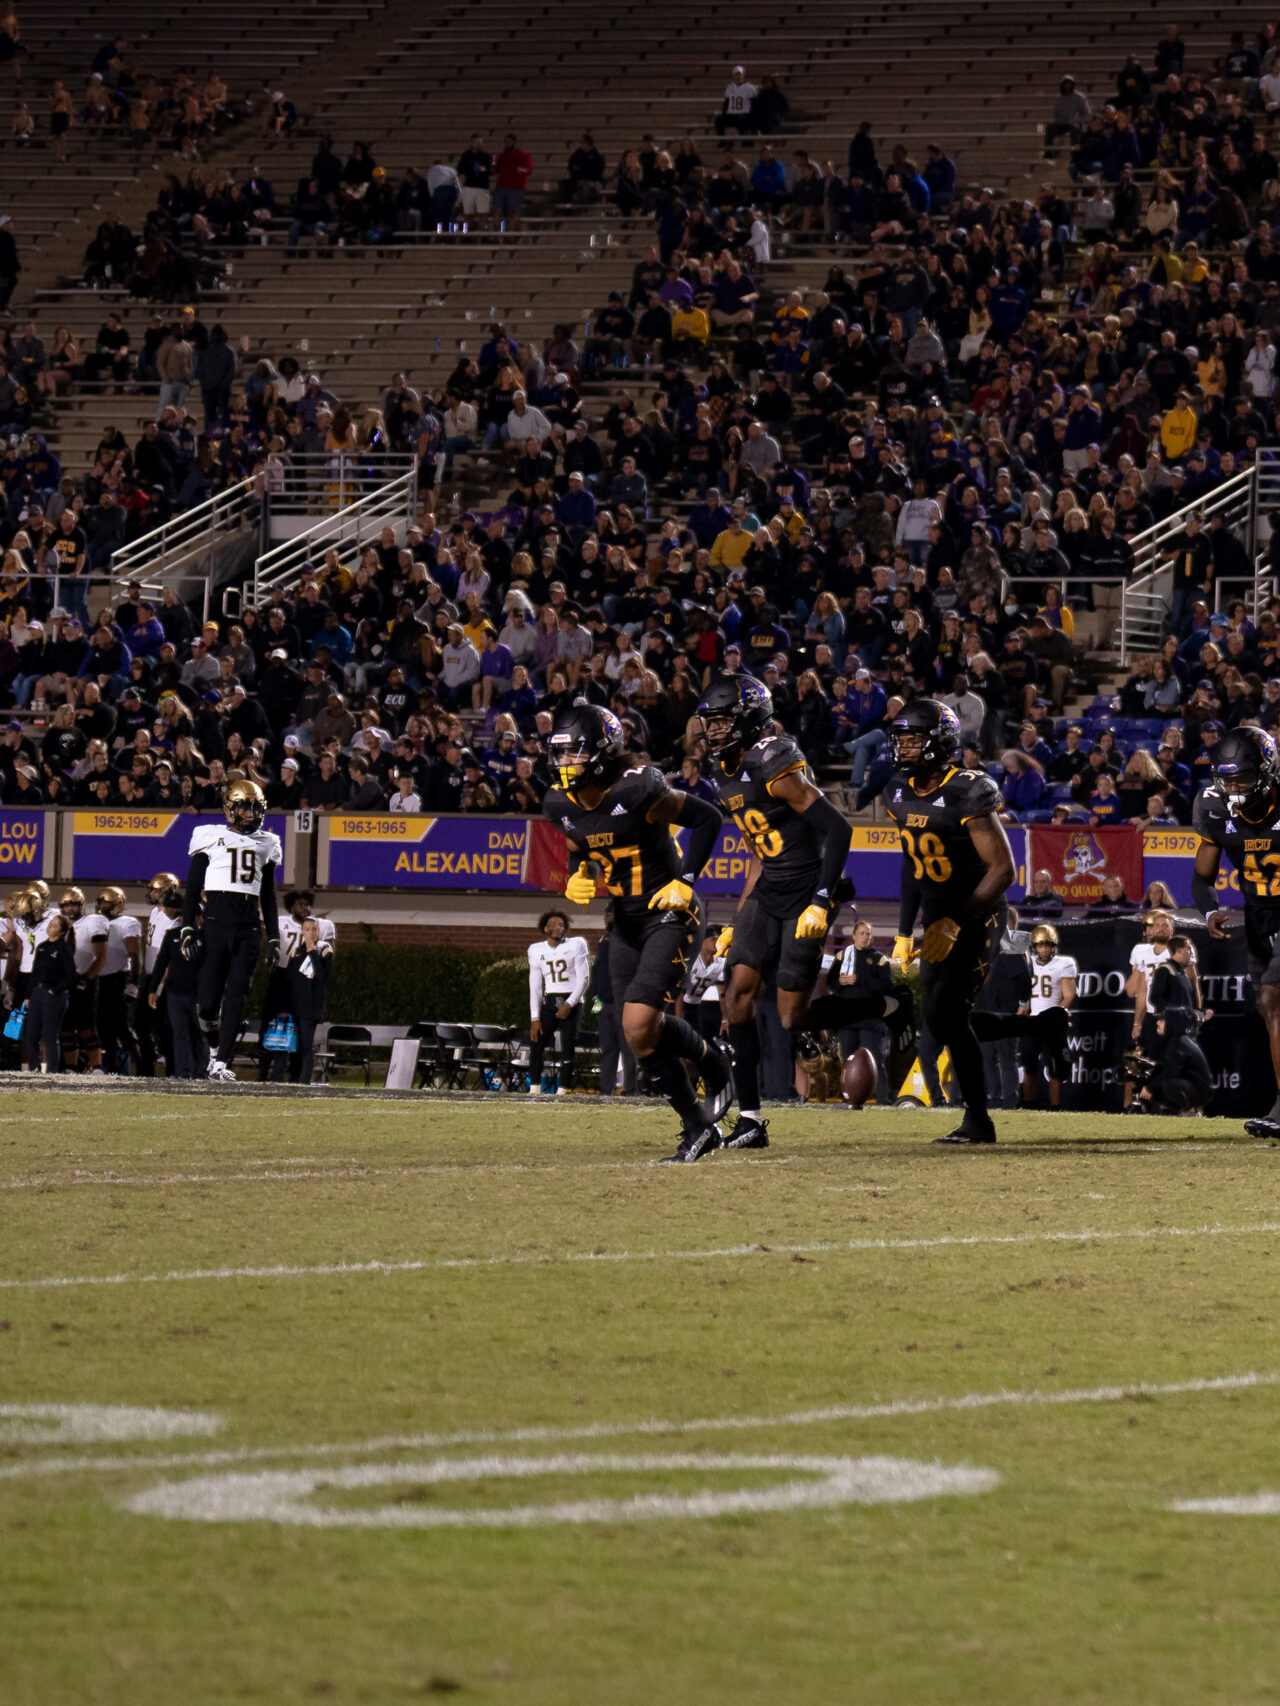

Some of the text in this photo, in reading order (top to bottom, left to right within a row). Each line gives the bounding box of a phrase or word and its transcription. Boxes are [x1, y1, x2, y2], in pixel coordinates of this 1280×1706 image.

[385, 693, 406, 705] ECU
[94, 815, 159, 829] 1962-1964
[296, 812, 311, 831] 15
[342, 821, 407, 835] 1963-1965
[906, 813, 929, 829] ECU
[2, 823, 37, 839] LOU
[586, 832, 614, 849] ECU
[1244, 838, 1273, 852] ECU
[226, 847, 257, 884] 19
[394, 851, 525, 876] ALEXANDE
[546, 958, 569, 983] 12
[1031, 974, 1052, 998] 26
